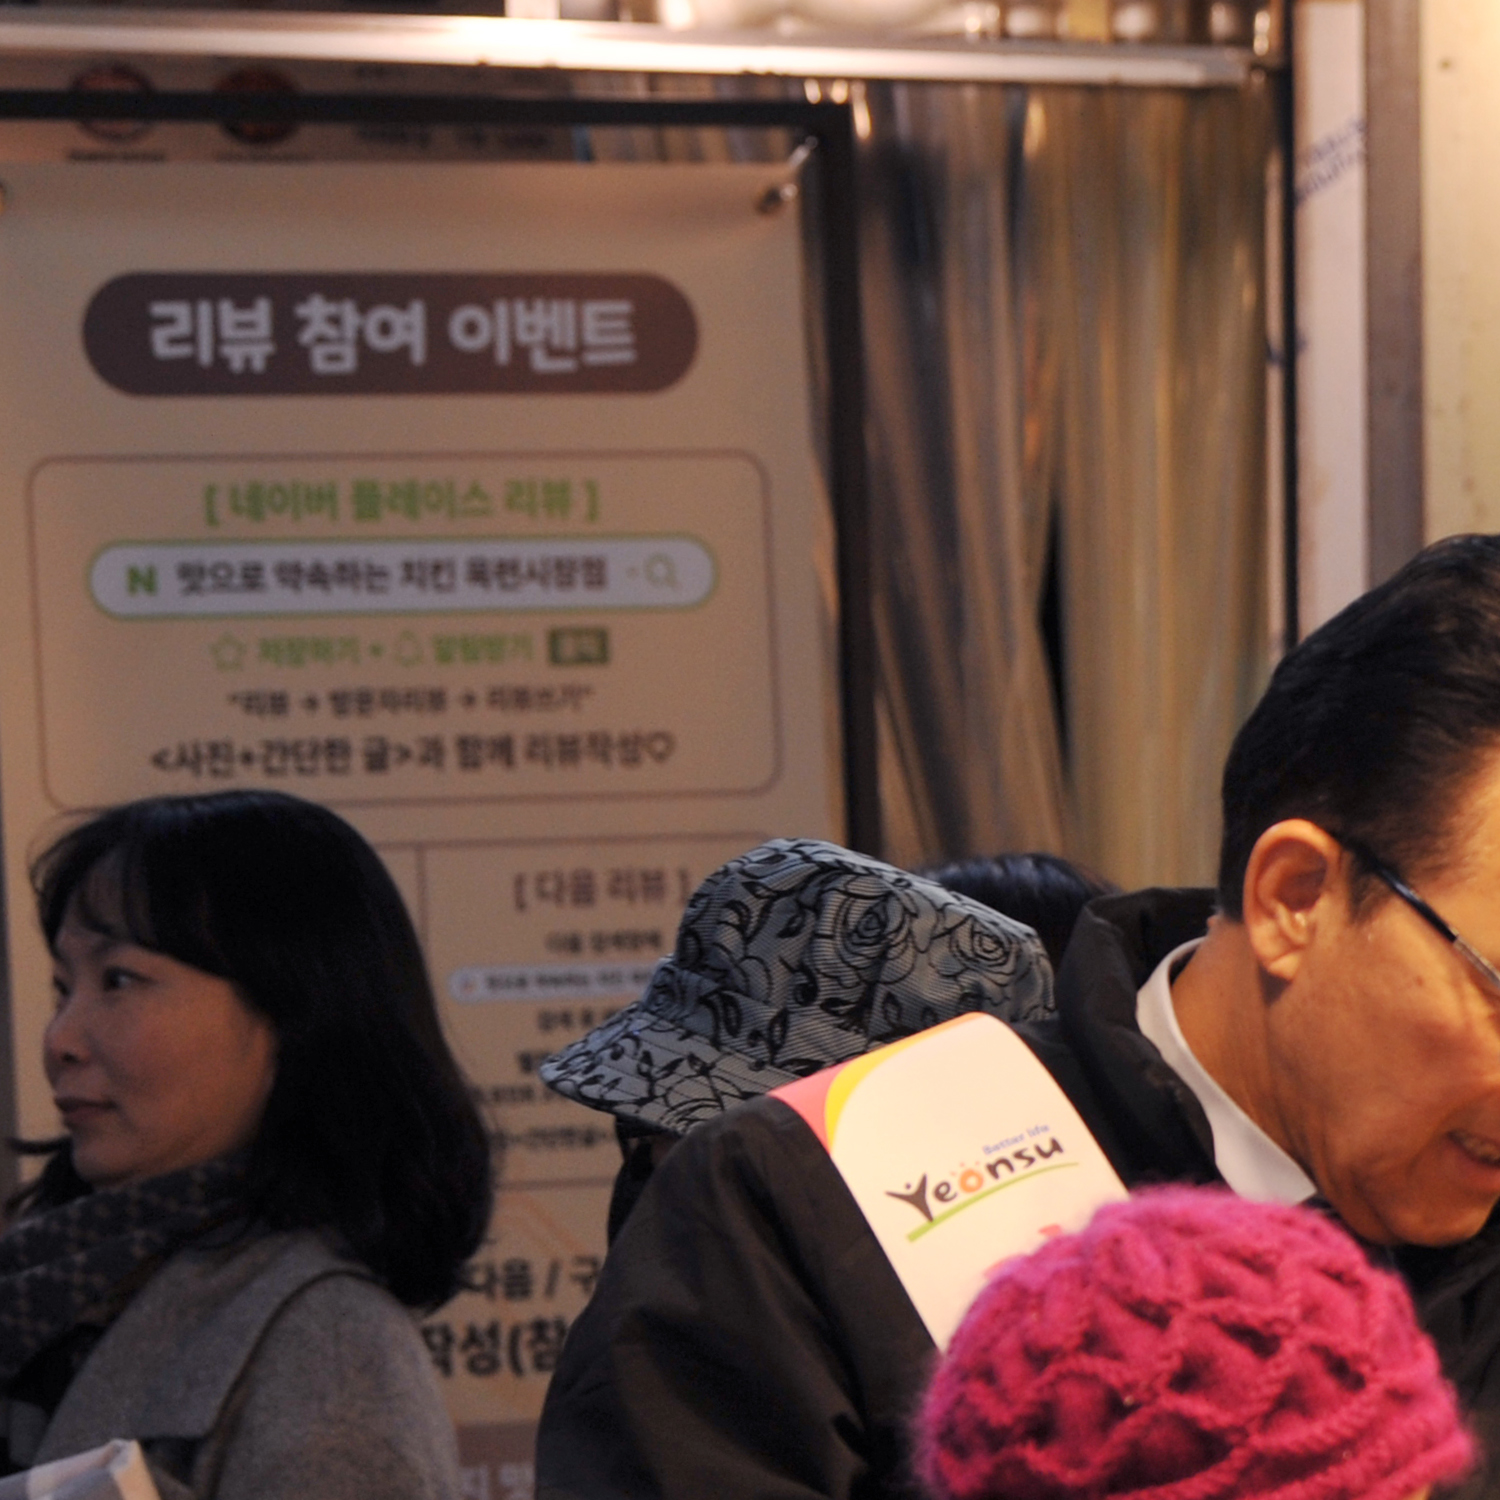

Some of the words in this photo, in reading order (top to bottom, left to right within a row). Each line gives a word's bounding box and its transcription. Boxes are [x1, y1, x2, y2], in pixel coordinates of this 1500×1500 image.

[148, 298, 276, 374] 리뷰
[294, 294, 428, 375] 참여
[447, 298, 637, 374] 이벤트
[231, 479, 338, 521] 네이버
[353, 478, 494, 522] 플레이스
[506, 479, 573, 518] 리뷰
[402, 555, 456, 591] 치킨
[982, 1132, 1026, 1157] Better
[1027, 1122, 1051, 1143] life
[885, 1138, 1064, 1222] Yeonsu
